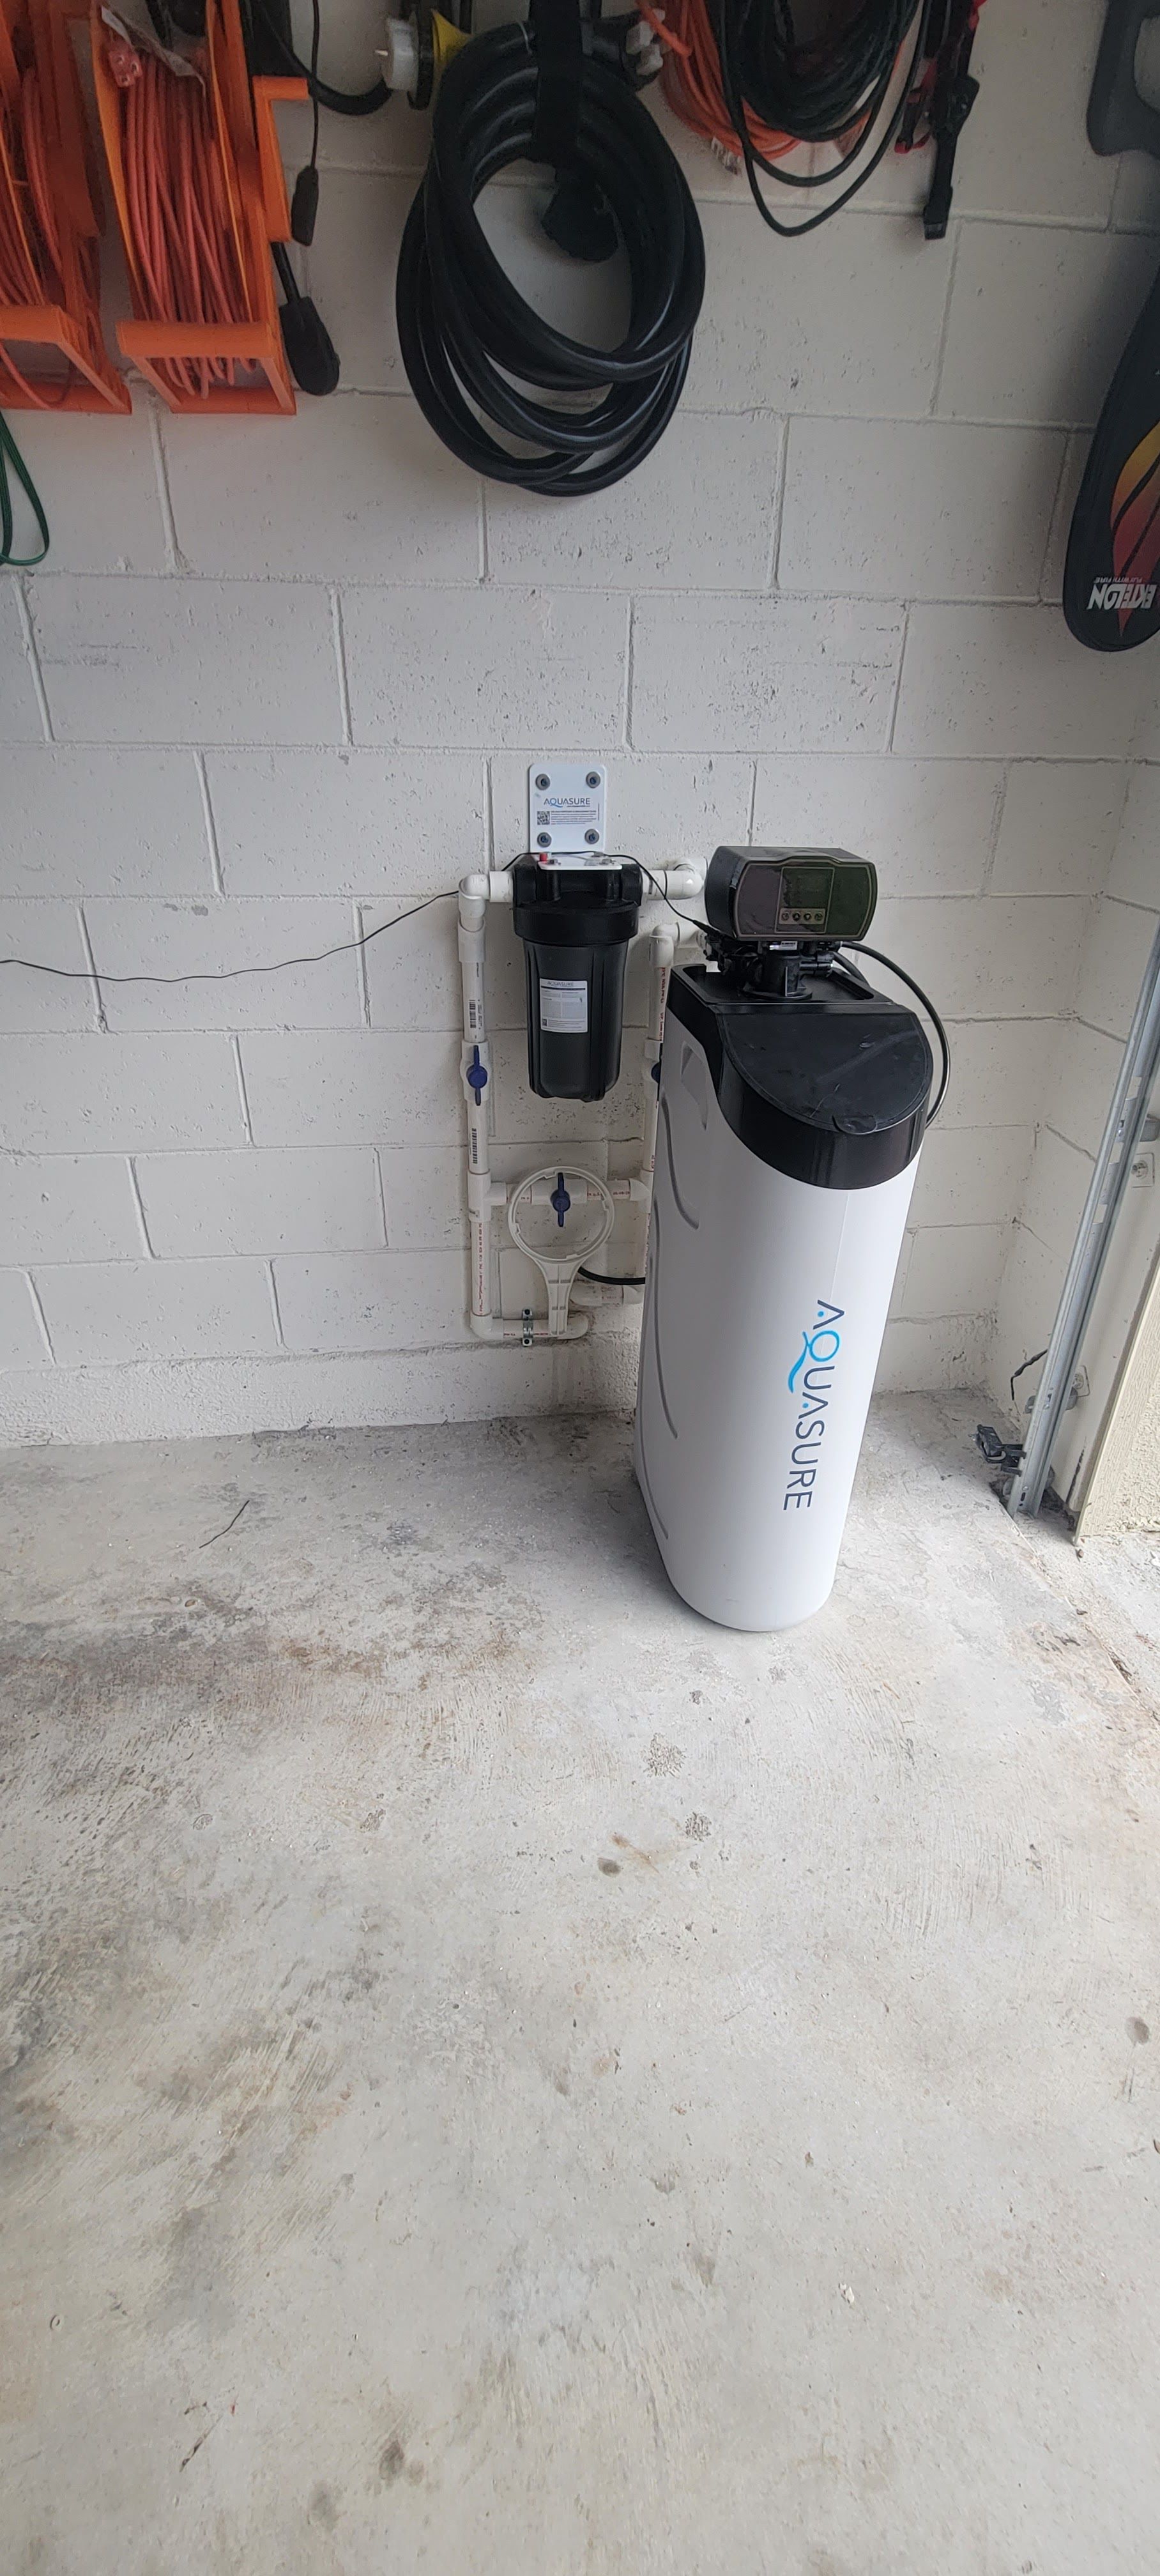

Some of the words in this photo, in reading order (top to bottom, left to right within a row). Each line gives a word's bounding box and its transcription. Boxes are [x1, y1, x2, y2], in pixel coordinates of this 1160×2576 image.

[1087, 583, 1157, 610] EKTELON
[544, 797, 591, 808] AQUASURE
[783, 1299, 845, 1511] AQUASURE
